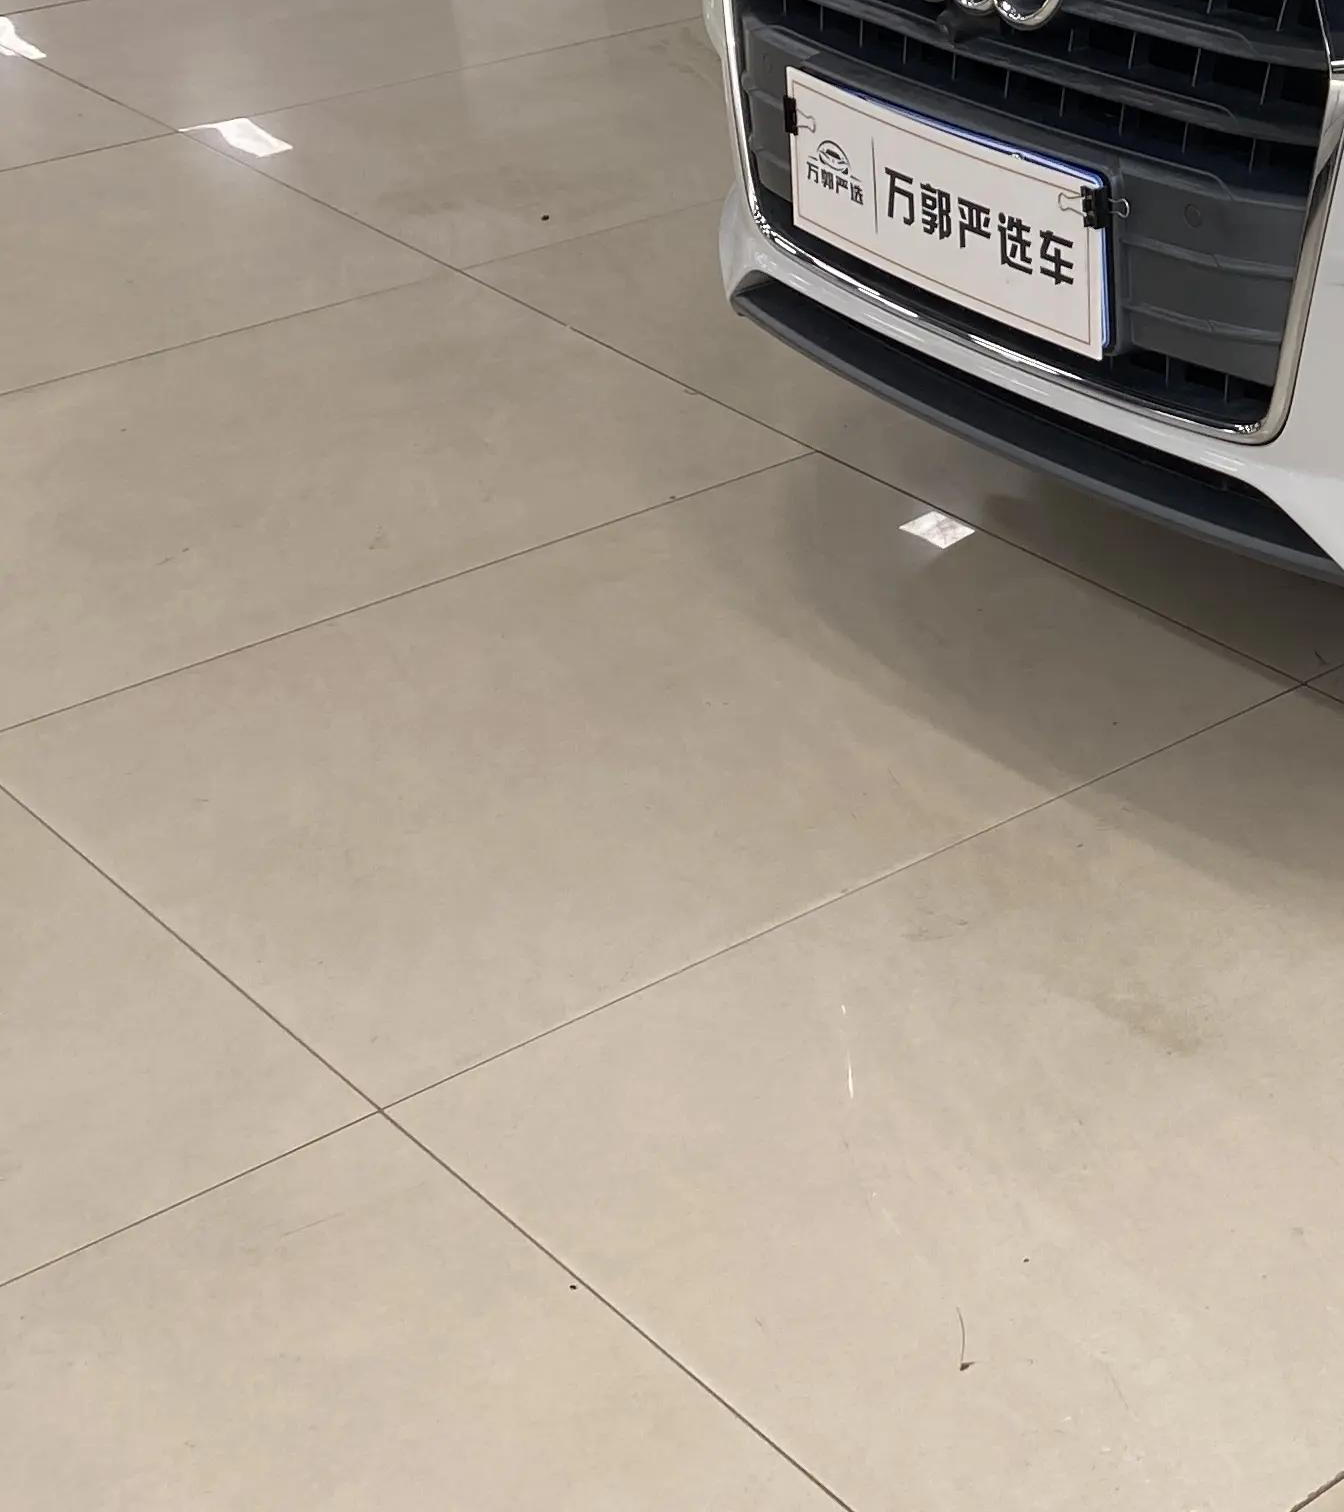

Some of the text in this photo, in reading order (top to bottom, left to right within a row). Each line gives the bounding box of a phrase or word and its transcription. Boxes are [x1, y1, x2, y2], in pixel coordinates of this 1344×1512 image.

[806, 161, 864, 206] 万郭严选
[885, 167, 1074, 285] 万郭严选车
